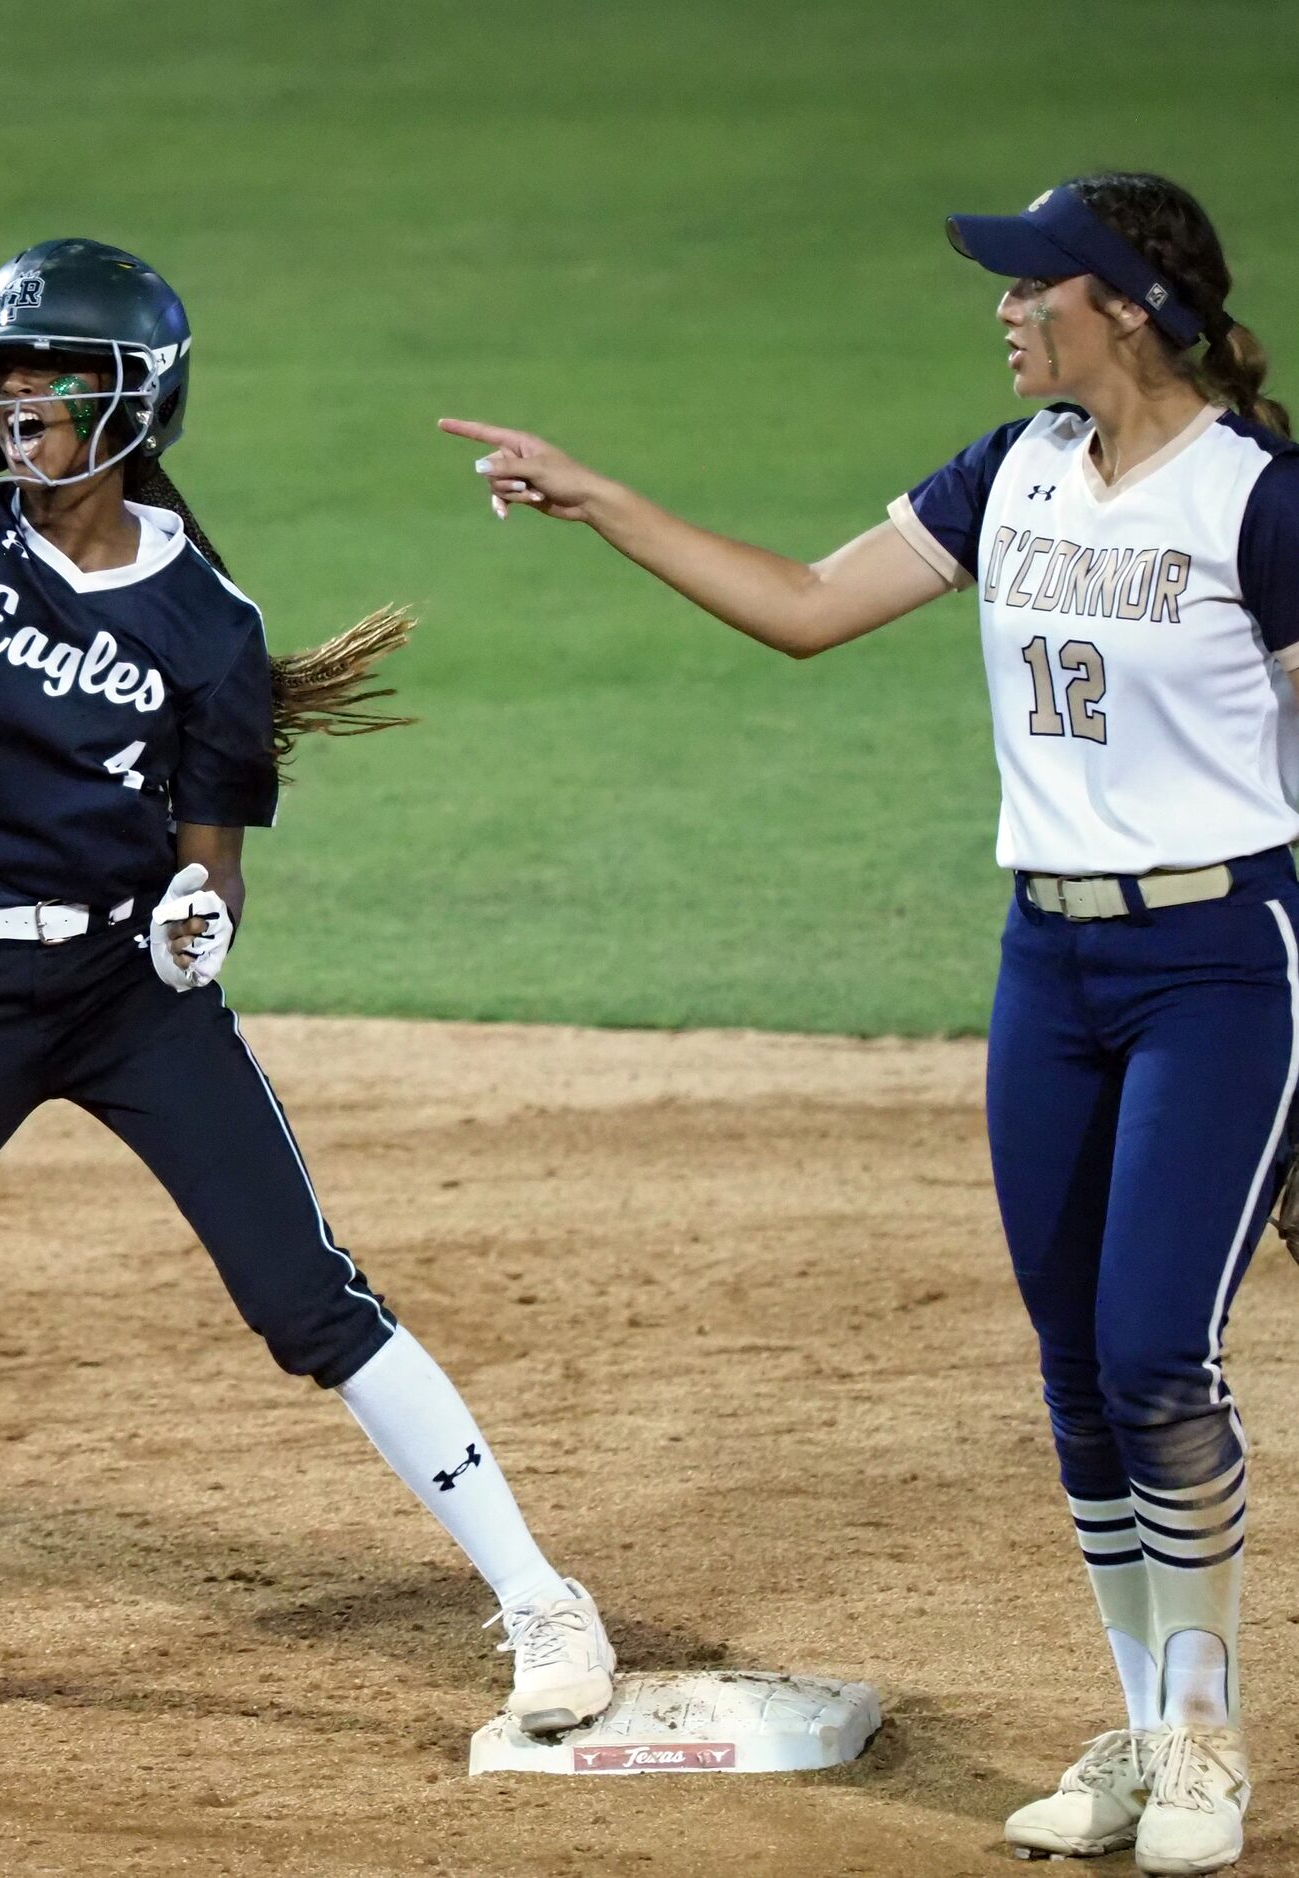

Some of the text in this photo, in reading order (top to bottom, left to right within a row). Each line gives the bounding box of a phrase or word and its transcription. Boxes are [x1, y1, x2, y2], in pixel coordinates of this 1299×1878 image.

[984, 526, 1191, 623] O'CONNOR
[1021, 635, 1107, 745] 12
[103, 740, 146, 789] 4
[622, 1746, 686, 1768] Texas
